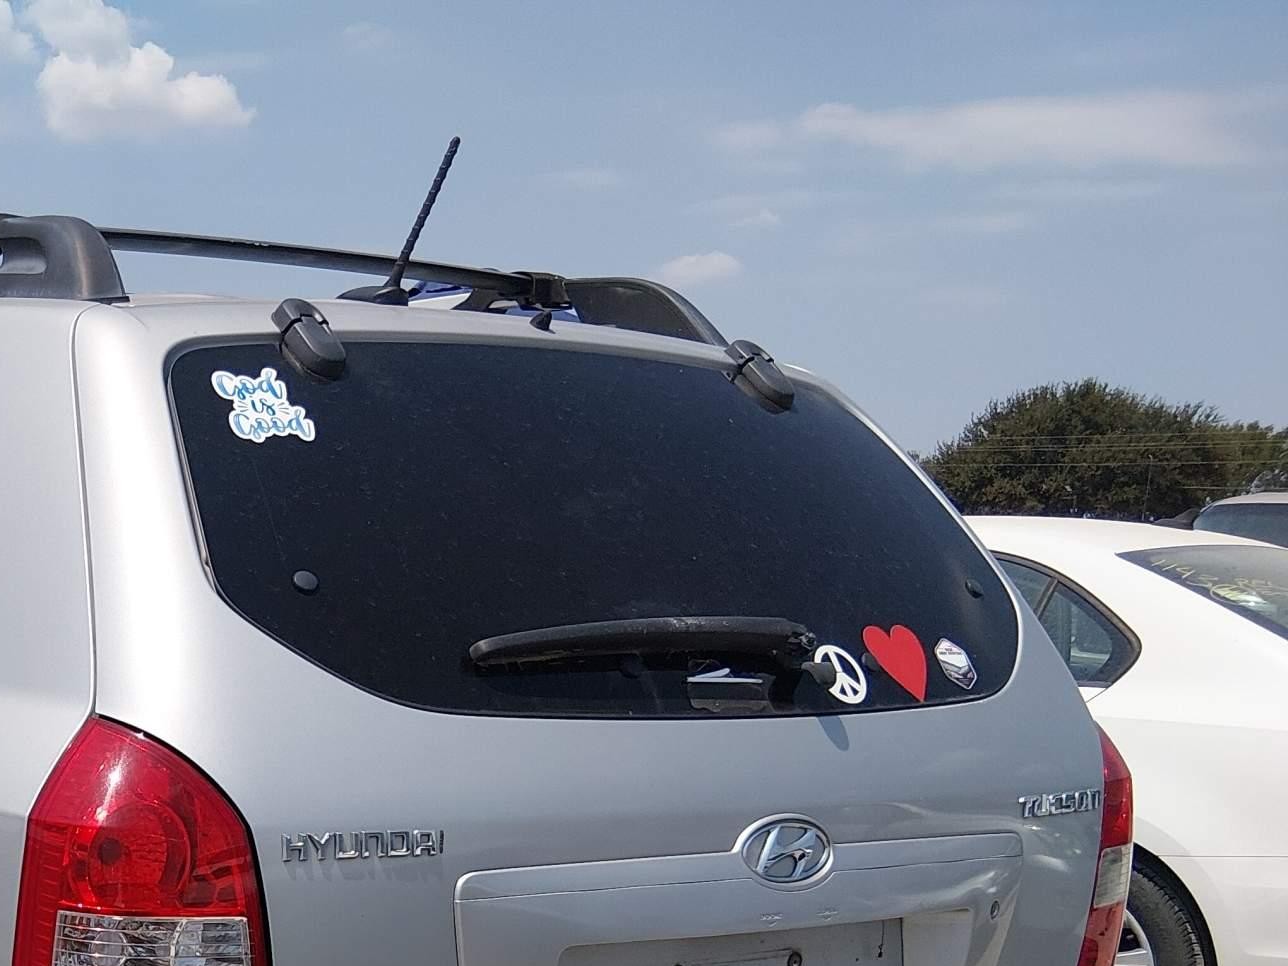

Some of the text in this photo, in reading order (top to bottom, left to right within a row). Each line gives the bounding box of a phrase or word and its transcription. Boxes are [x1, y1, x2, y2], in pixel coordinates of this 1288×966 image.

[215, 370, 283, 400] God
[250, 396, 276, 416] is
[233, 408, 313, 440] Good
[1018, 788, 1102, 818] TUCSON
[281, 829, 445, 862] HYUNDAI
